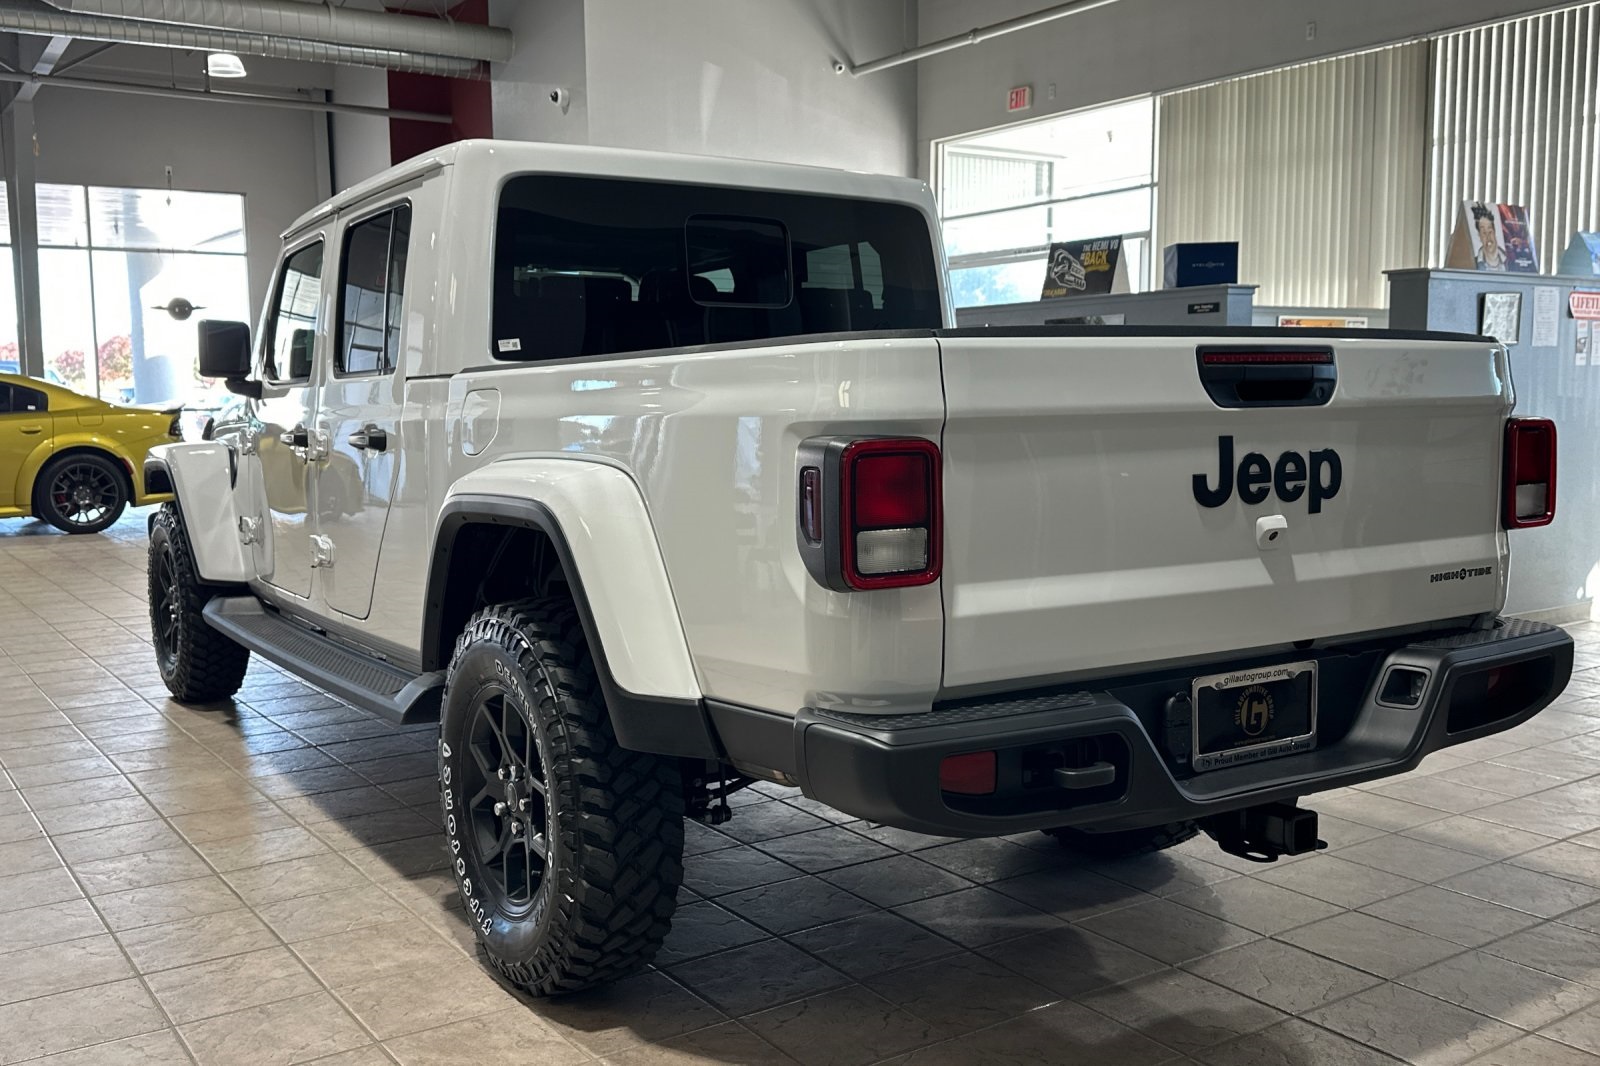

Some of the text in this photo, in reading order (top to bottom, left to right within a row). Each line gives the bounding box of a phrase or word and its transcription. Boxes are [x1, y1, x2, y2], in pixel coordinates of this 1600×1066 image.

[1009, 88, 1026, 110] EXIT
[1083, 239, 1119, 252] THE HEMI V8
[1084, 250, 1109, 265] BACK
[1572, 296, 1600, 309] LIFETI
[1192, 435, 1343, 514] Jeep
[1430, 566, 1492, 583] HIGH TIDE
[1223, 669, 1289, 686] gillautogroup.com
[1237, 685, 1268, 707] AUTOMOTIVE
[1214, 742, 1311, 766] Proud Member of Gill Auto Group
